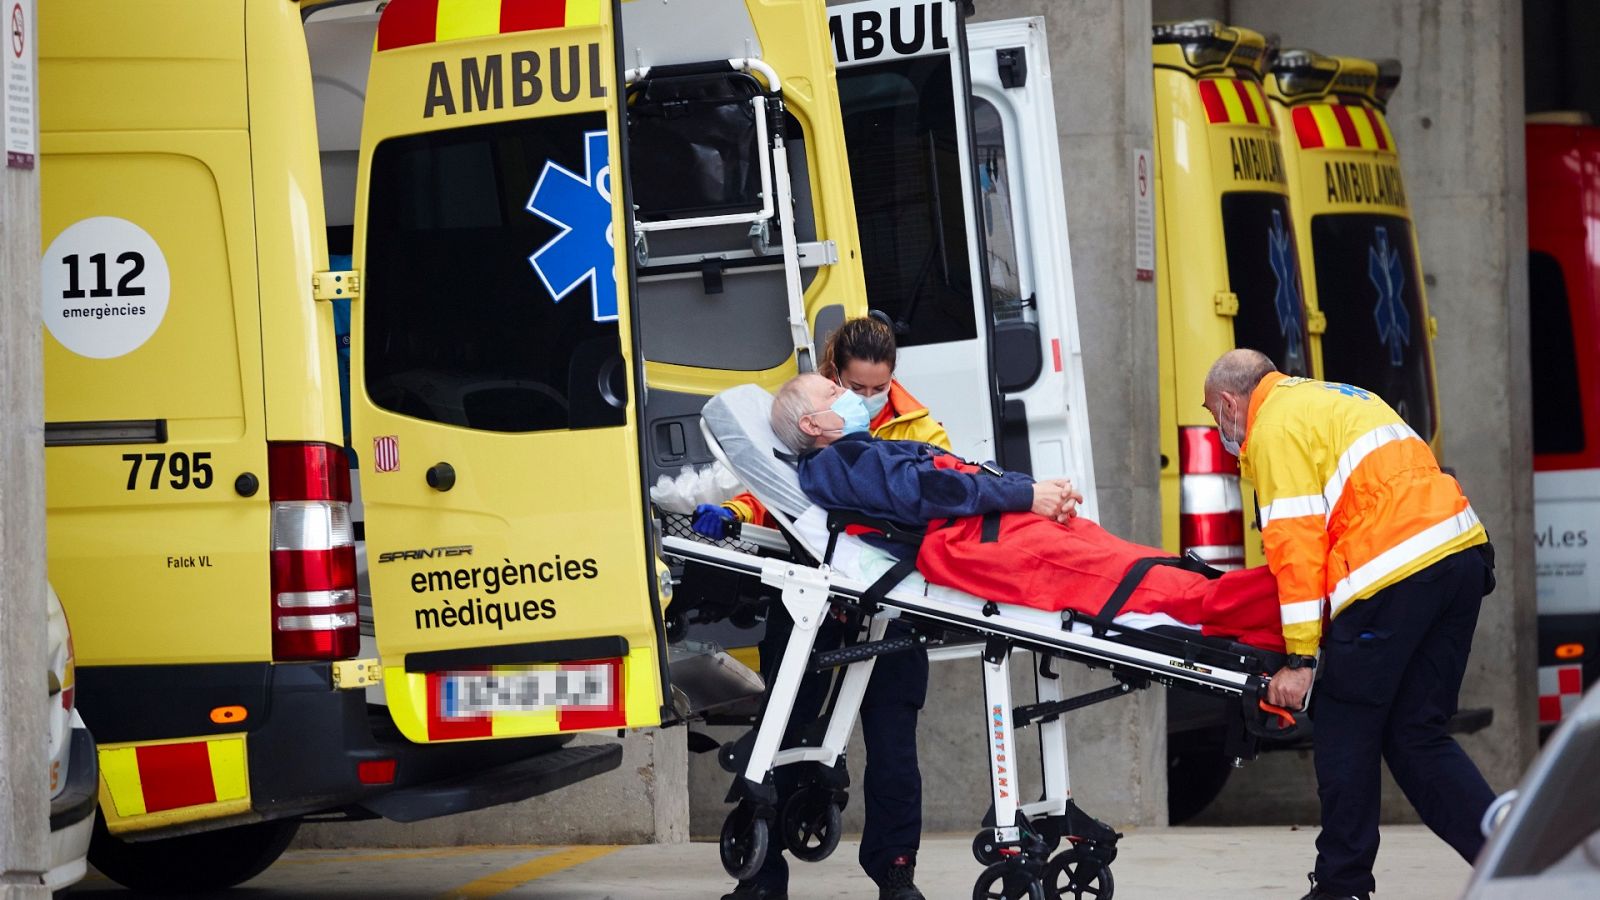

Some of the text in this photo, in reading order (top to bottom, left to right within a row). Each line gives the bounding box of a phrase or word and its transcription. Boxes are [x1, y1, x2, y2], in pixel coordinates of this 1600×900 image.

[423, 43, 608, 118] AMBUL
[62, 251, 146, 299] 112
[62, 304, 146, 320] emergències
[122, 451, 214, 491] 7795
[167, 555, 213, 568] Falck VL
[377, 544, 473, 564] SPRINTER
[411, 554, 598, 595] emergències
[415, 597, 557, 631] mèdiques
[993, 704, 1009, 799] KARTSANA
